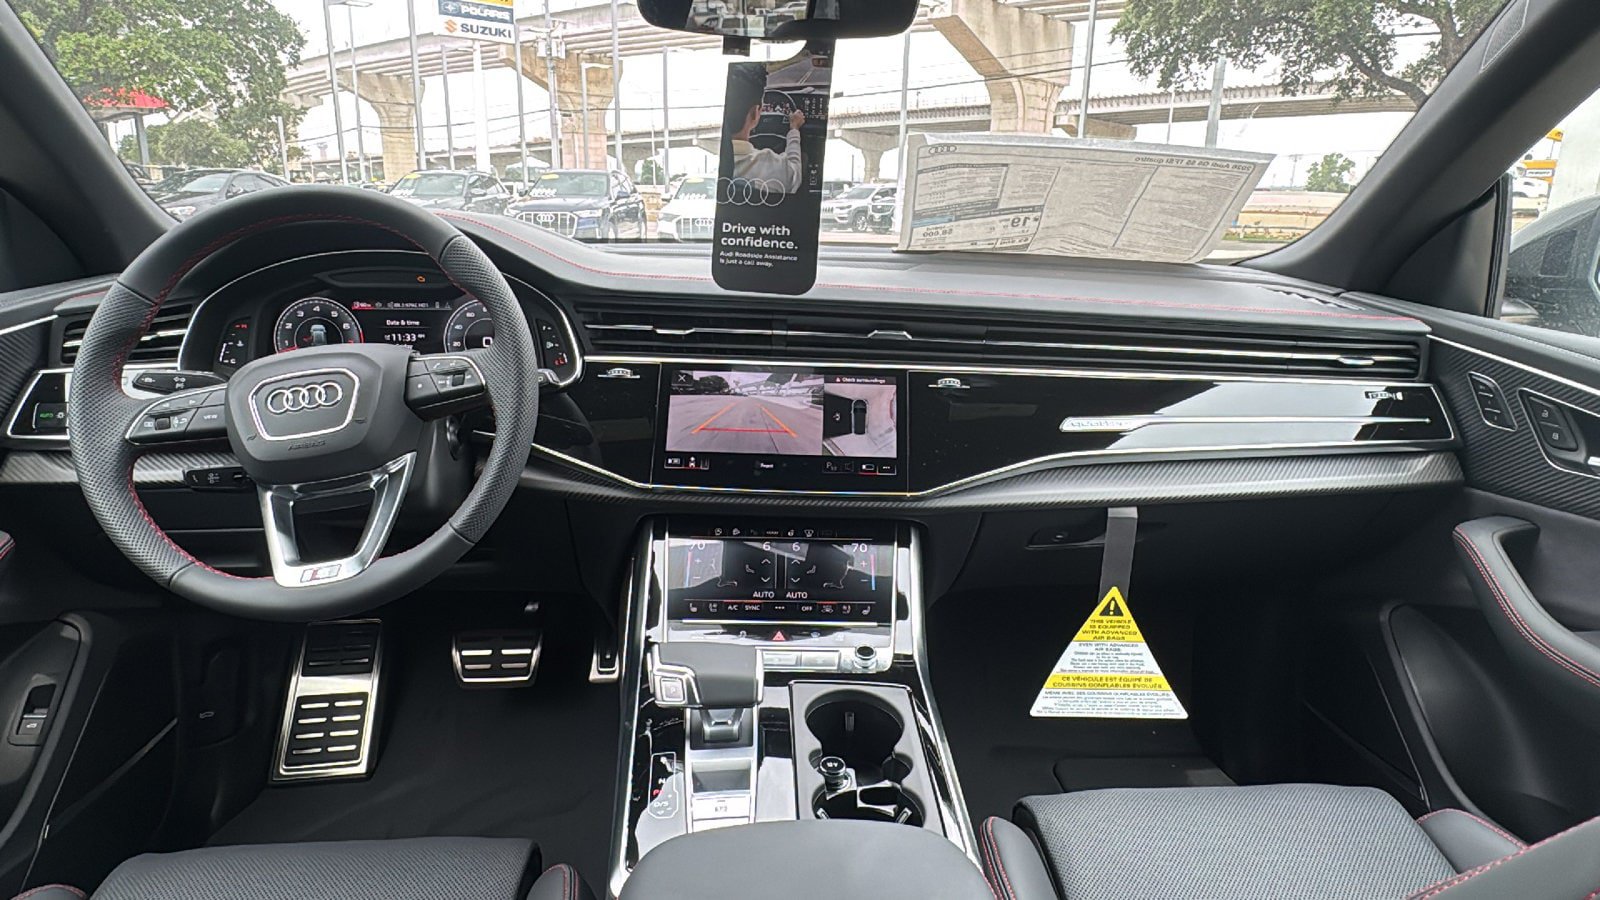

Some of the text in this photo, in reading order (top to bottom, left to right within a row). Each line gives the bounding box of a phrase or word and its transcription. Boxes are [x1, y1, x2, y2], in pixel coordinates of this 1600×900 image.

[461, 4, 510, 20] POLARIS
[460, 23, 512, 38] SUZUKI
[722, 222, 791, 236] Drive with
[721, 236, 798, 250] confidence.
[764, 253, 798, 261] Assistance
[392, 333, 416, 342] 11:33
[763, 541, 771, 551] 6
[792, 542, 800, 552] 6
[851, 543, 868, 553] 70
[753, 590, 808, 599] AUTO AUTO
[745, 604, 761, 612] SYNC
